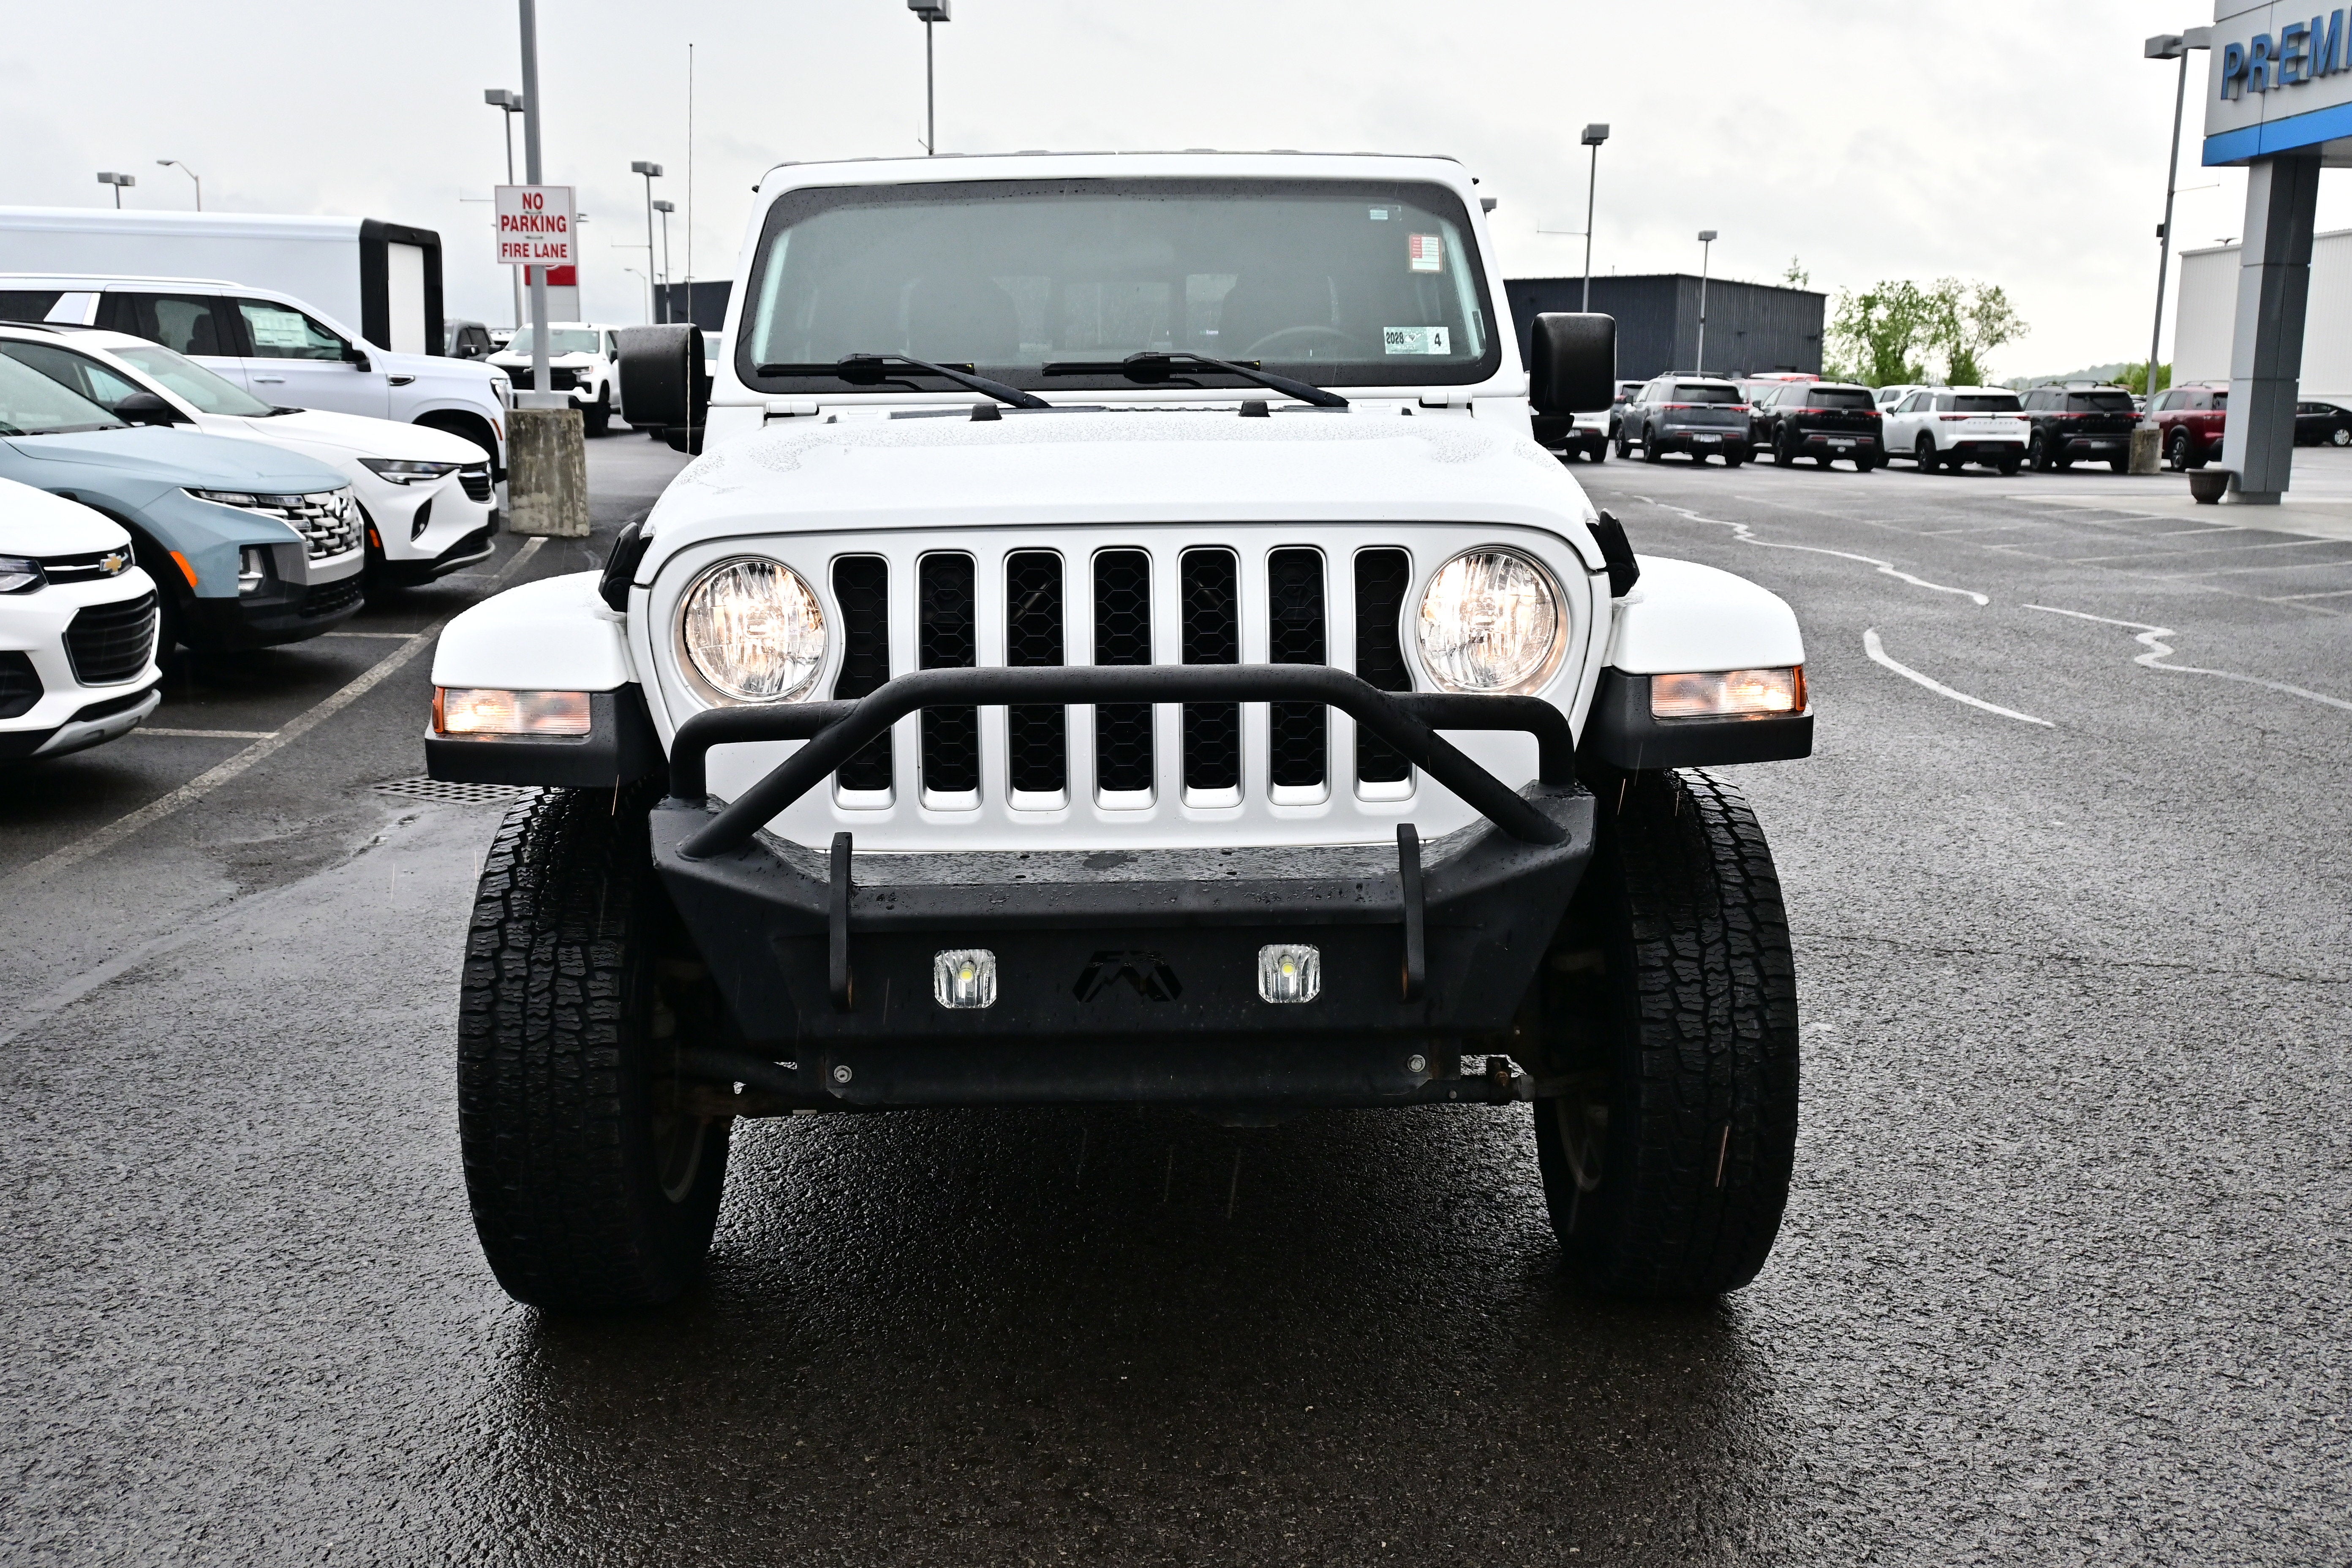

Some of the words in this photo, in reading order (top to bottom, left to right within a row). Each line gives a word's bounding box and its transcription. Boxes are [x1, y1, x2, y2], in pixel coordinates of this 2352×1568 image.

[522, 192, 543, 210] NO
[501, 214, 567, 232] PARKING
[501, 242, 530, 257] FIRE
[534, 242, 567, 258] LANE
[1386, 332, 1404, 344] 2028
[1434, 332, 1442, 347] 4
